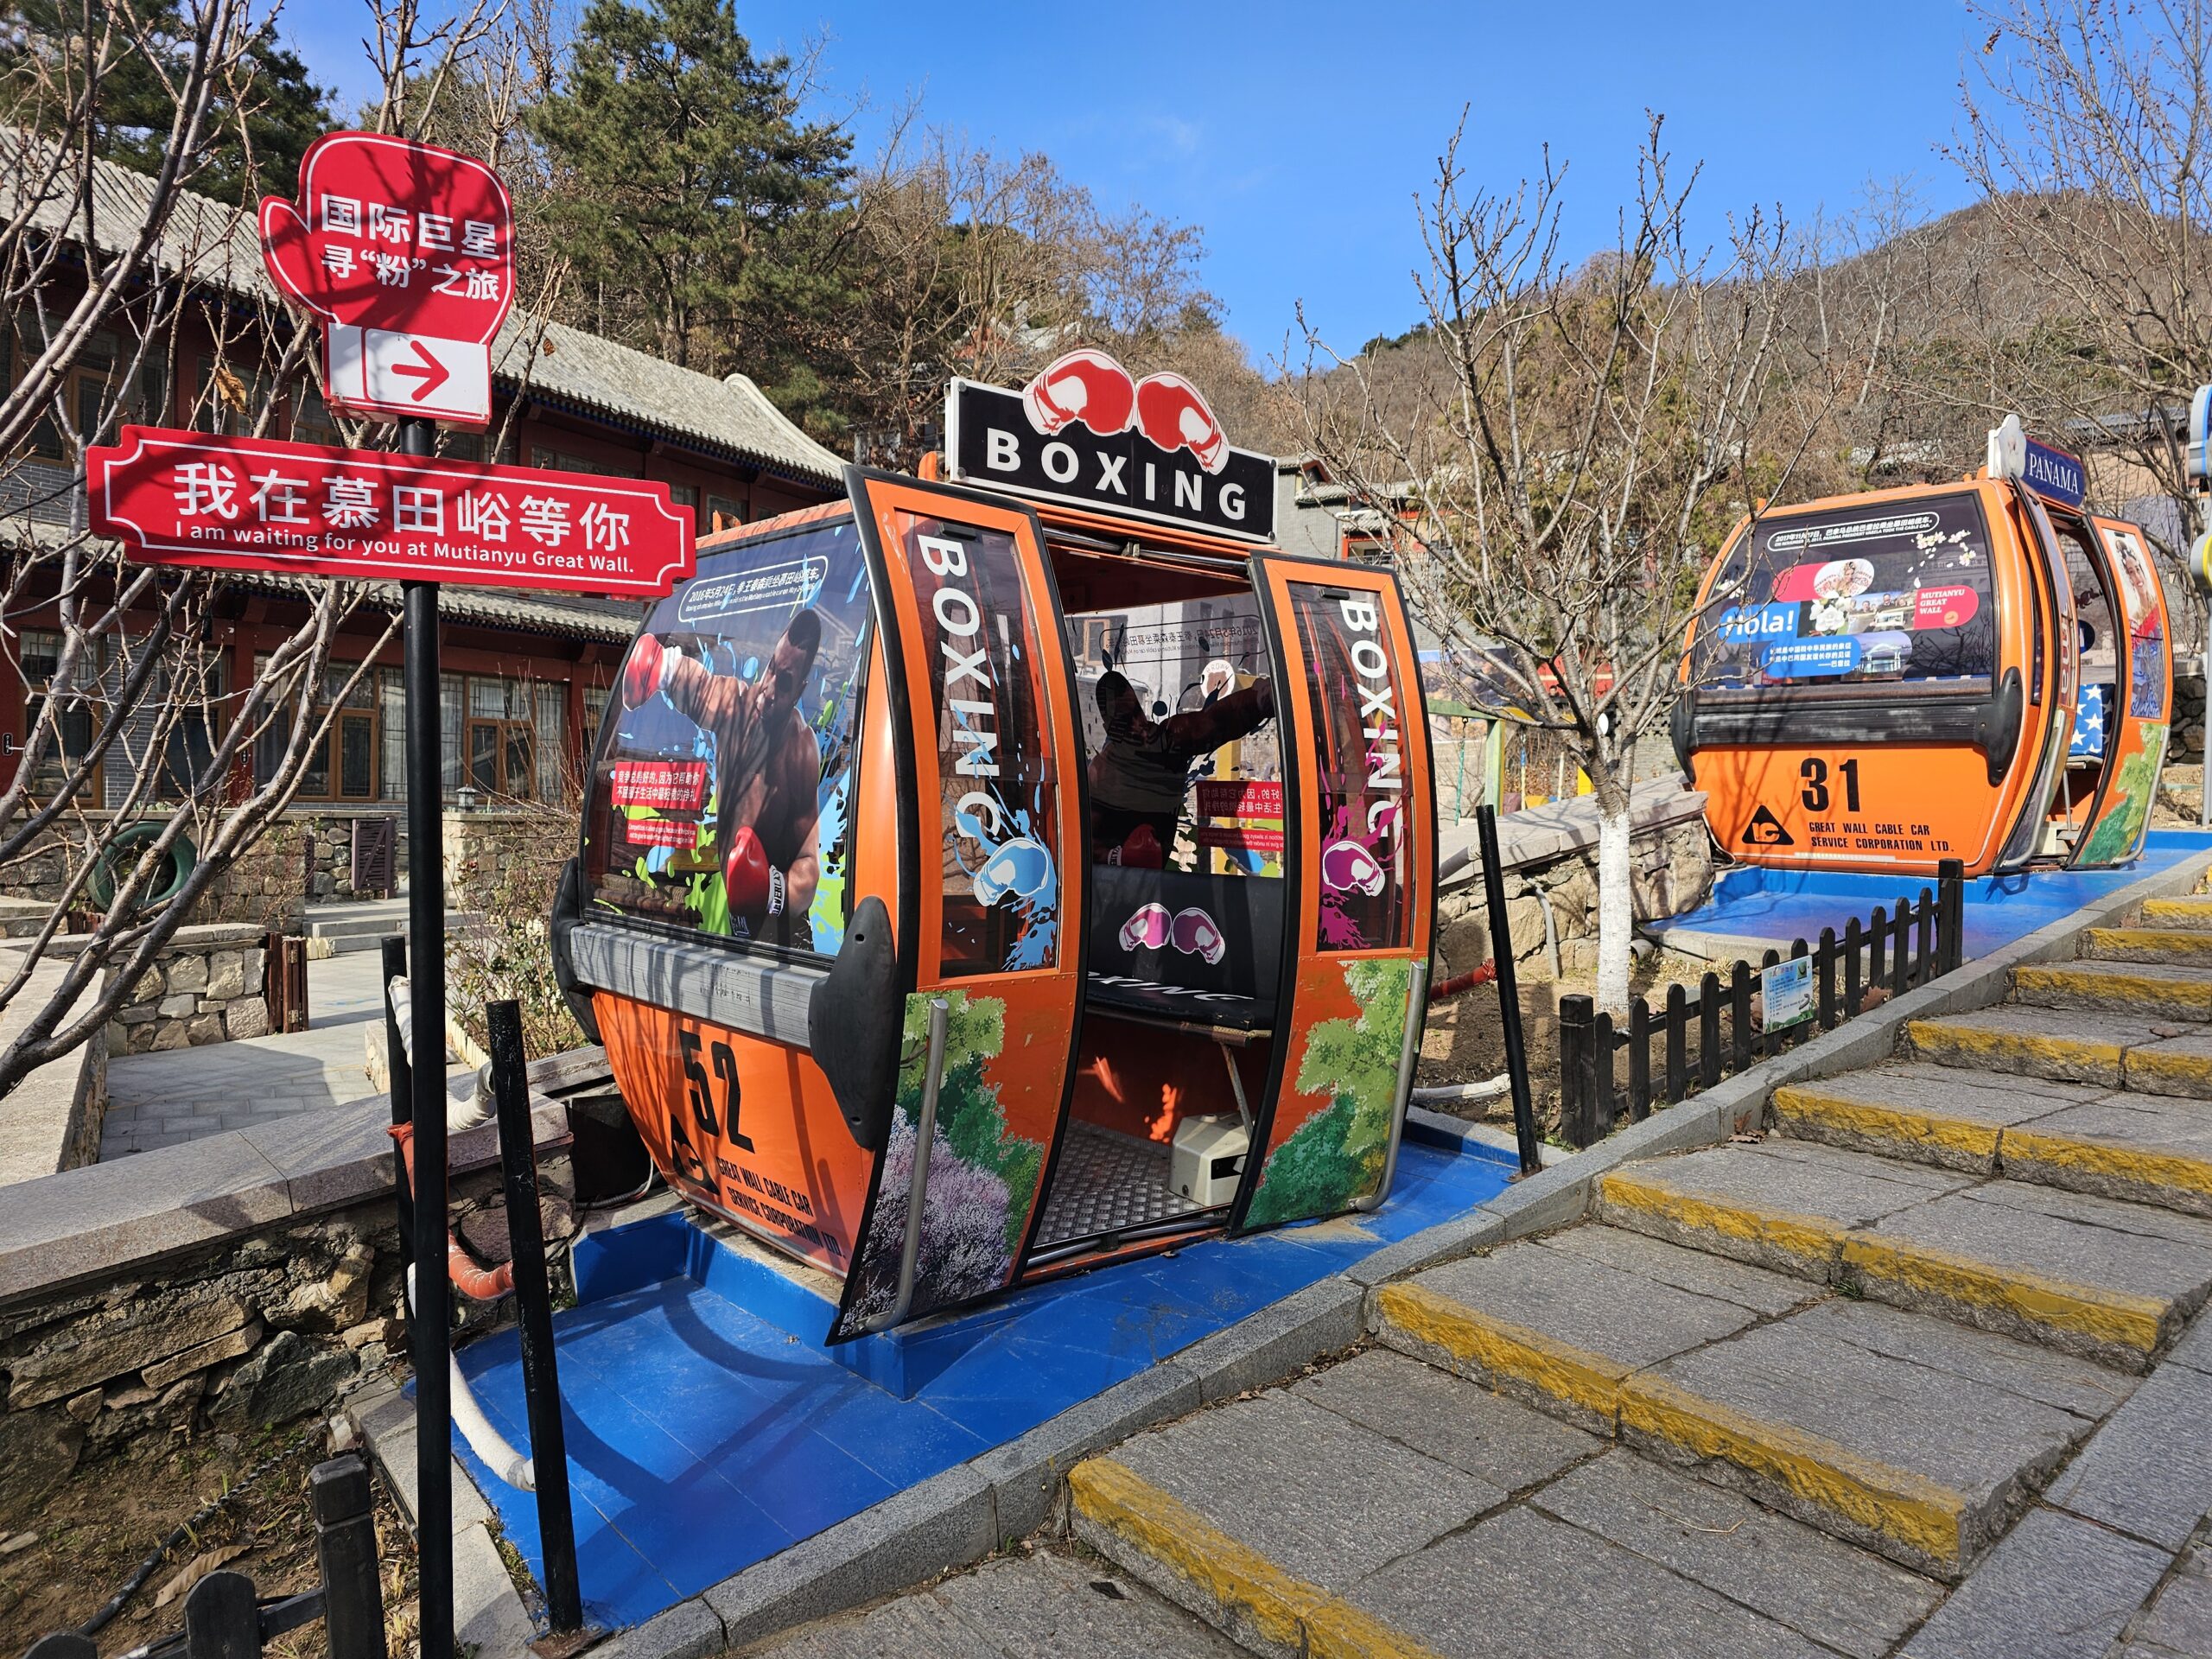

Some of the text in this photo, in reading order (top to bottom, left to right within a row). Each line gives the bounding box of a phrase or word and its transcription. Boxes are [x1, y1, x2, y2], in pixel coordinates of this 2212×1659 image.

[321, 193, 500, 260] 国际巨星
[986, 427, 1246, 521] BOXING
[2029, 452, 2080, 495] PANAMA
[174, 462, 630, 551] 我在慕田峪等你
[175, 521, 634, 573] I am waiting for you at Mutianyu Great Wall.
[1919, 606, 1942, 615] WALL
[1920, 598, 1948, 608] GREAT
[1921, 588, 1966, 601] MUTIANYU
[1724, 610, 1794, 637] Hola!
[917, 534, 1001, 838] BOXING
[1339, 600, 1403, 837] BOXING
[1801, 757, 1860, 812] 31
[1808, 822, 1930, 836] GREAT WALL CABLE CAR
[1811, 836, 1955, 852] SERVICE CORPORATION LTD.
[678, 1028, 755, 1154] 52
[716, 1155, 814, 1217] GREAT WALL CABLE CAR
[727, 1185, 846, 1260] SERVICE CORPORATION LTD.
